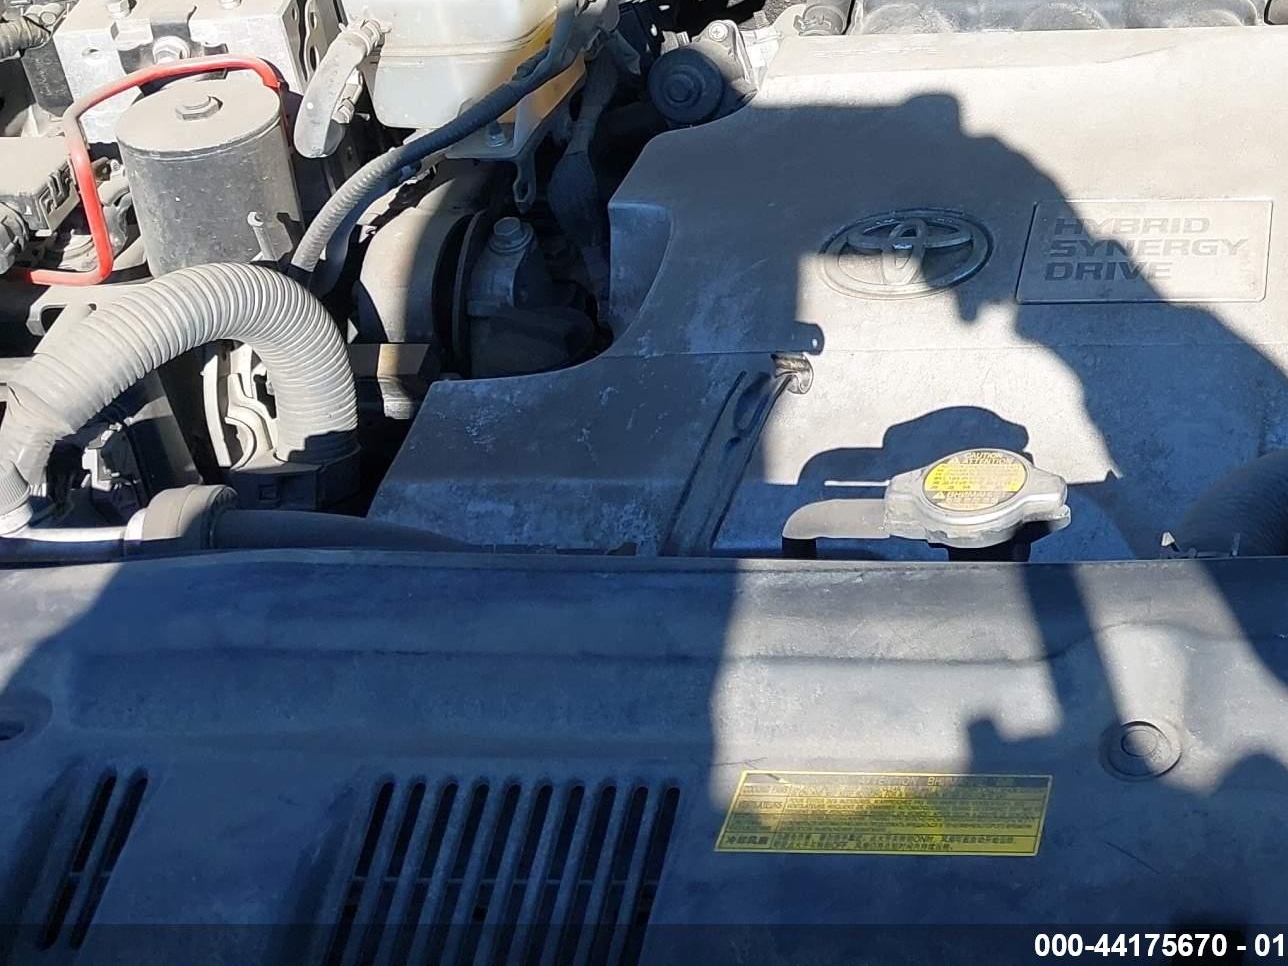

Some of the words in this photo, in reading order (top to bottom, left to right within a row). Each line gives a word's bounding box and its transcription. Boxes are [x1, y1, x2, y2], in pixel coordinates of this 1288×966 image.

[1054, 217, 1210, 235] HYBRID
[1049, 238, 1249, 257] SYNERGY
[1044, 261, 1173, 281] DRIVE
